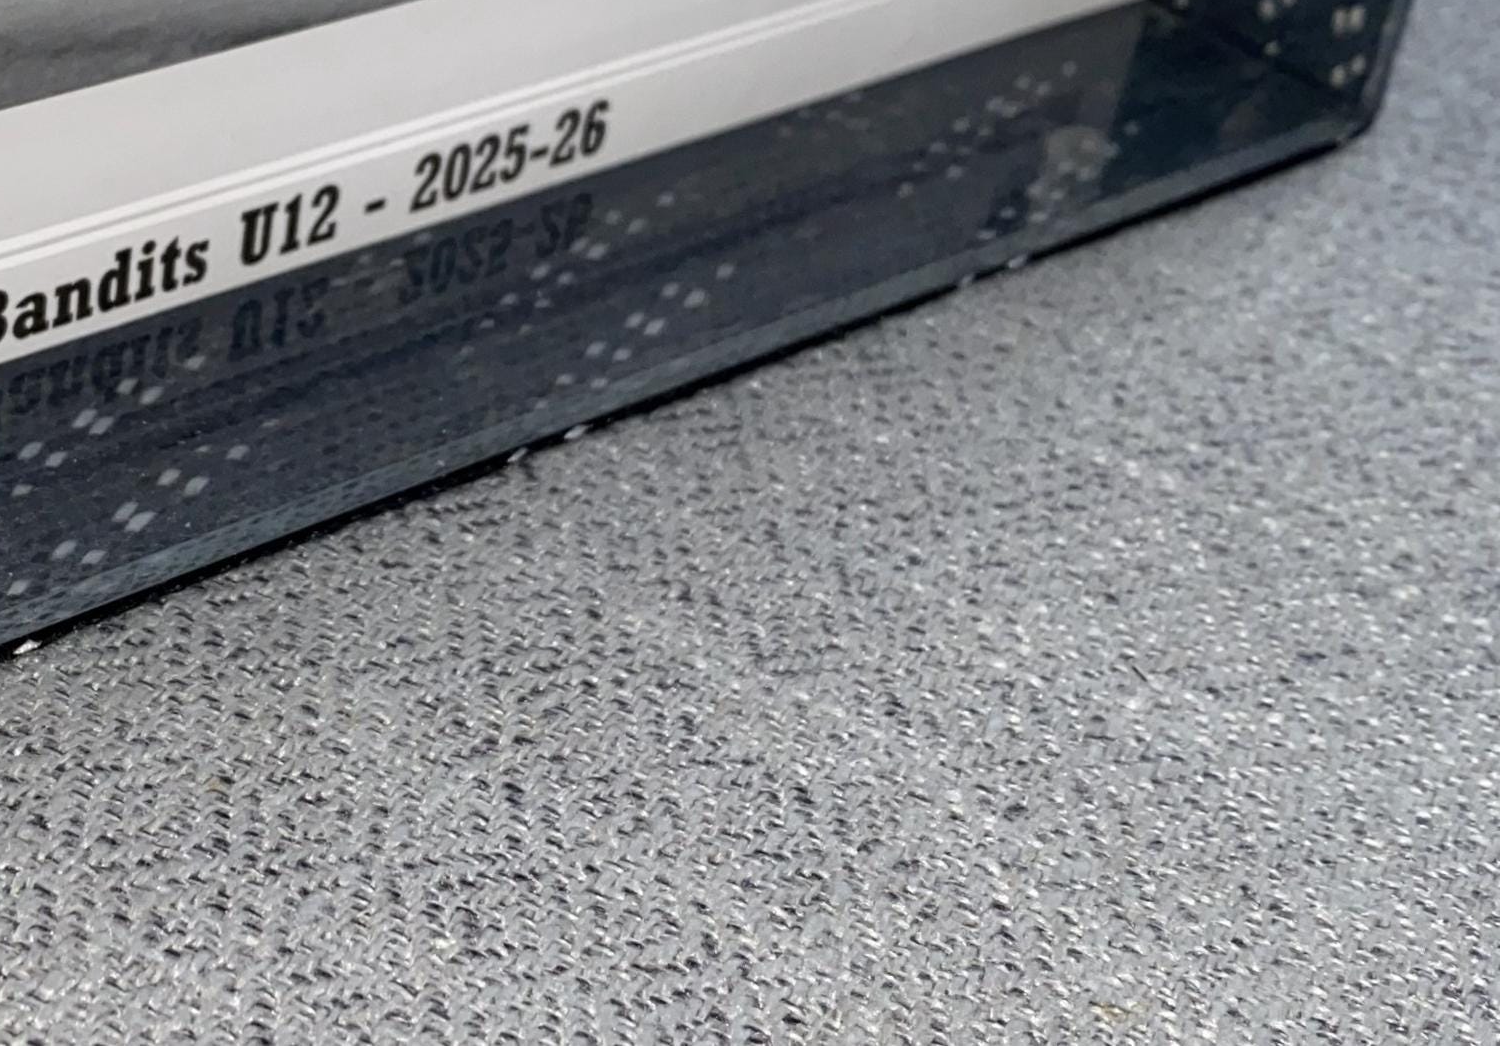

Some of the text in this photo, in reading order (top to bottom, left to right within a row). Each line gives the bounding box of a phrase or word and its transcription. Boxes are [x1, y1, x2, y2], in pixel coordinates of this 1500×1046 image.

[240, 184, 340, 267] U12
[364, 197, 387, 215] -
[409, 99, 611, 213] 2025-26
